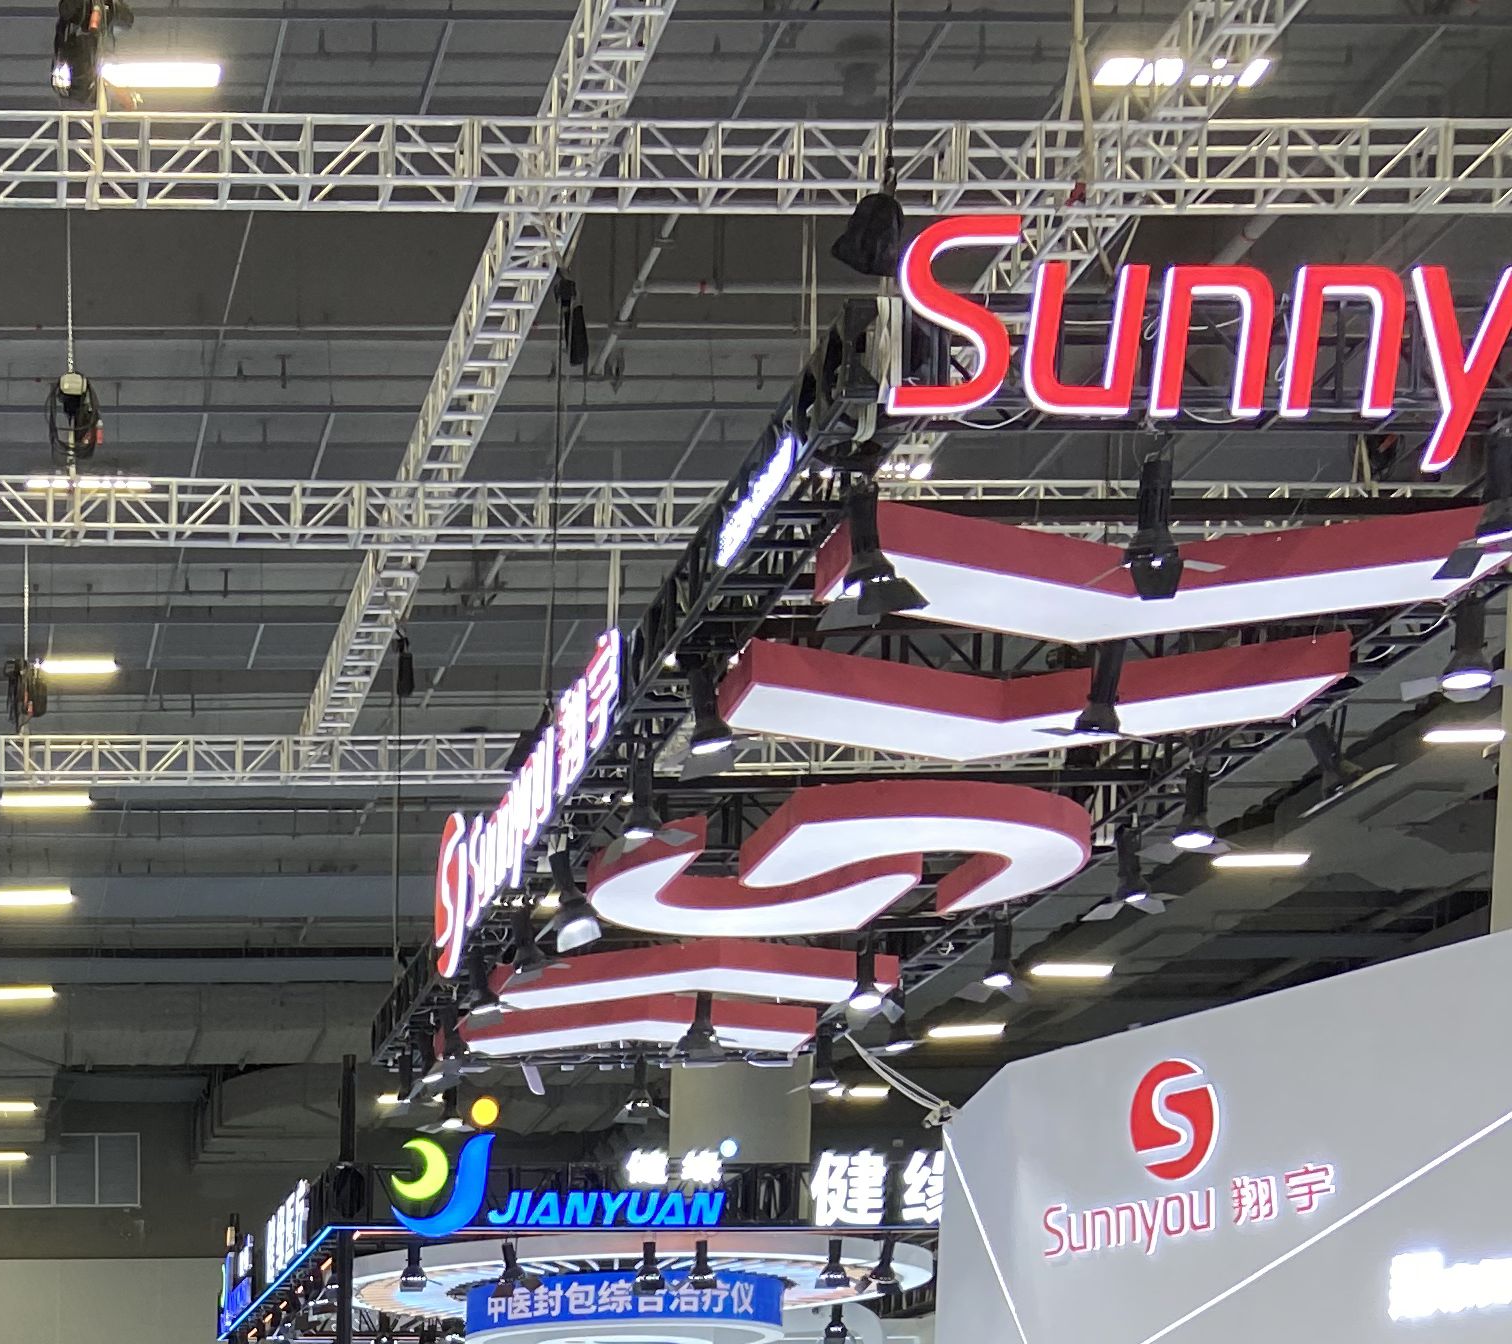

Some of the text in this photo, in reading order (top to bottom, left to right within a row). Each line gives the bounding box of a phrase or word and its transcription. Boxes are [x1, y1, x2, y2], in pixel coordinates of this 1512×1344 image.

[488, 1190, 726, 1226] JIANYUAN
[1042, 1162, 1337, 1259] Sunnyou 翔宇
[487, 1279, 755, 1323] 中医封包综合治疗仪
